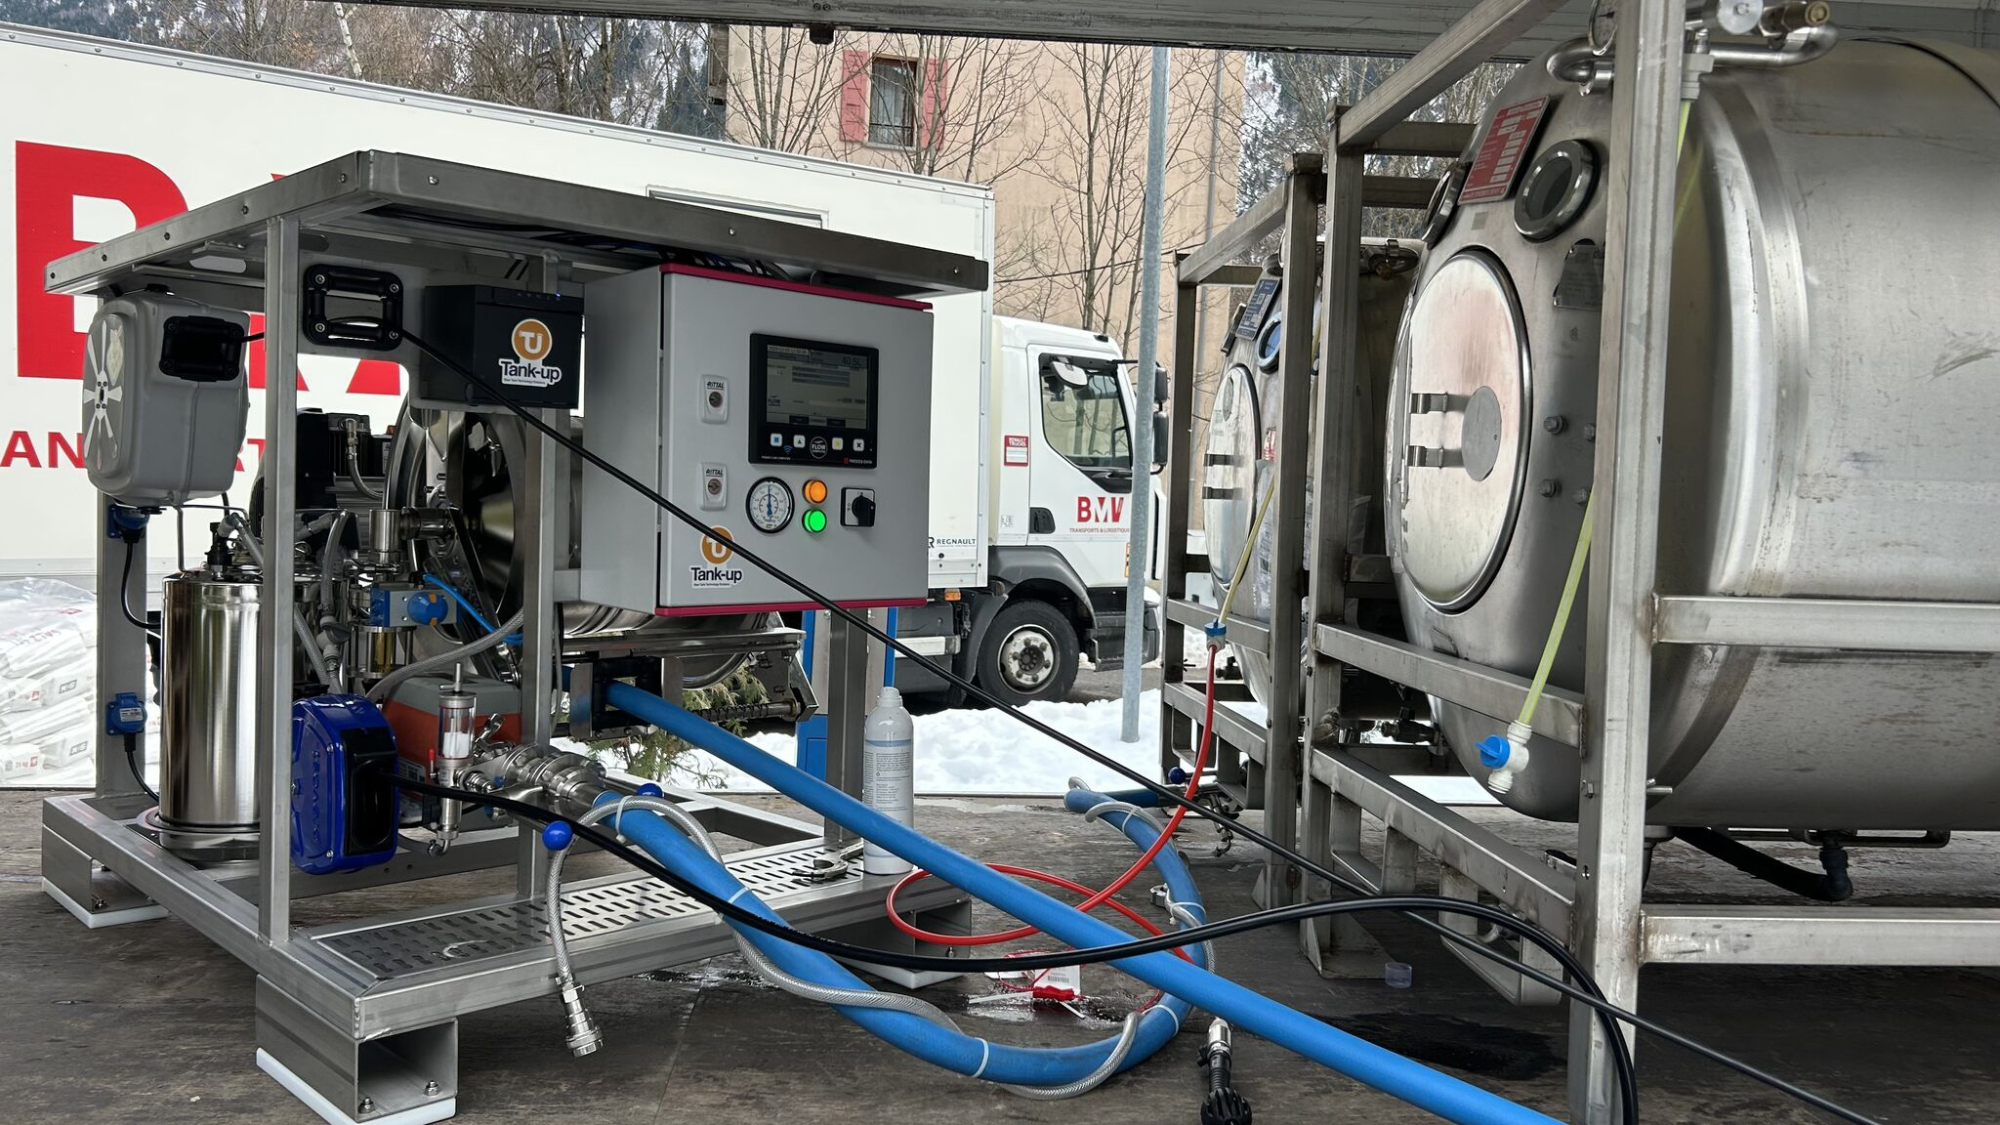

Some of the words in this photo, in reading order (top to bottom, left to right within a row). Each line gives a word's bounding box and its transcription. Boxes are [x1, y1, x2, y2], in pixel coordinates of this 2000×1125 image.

[500, 360, 561, 383] Tank-up
[706, 381, 725, 389] RITTAL
[705, 468, 724, 476] RITTAL
[1077, 496, 1124, 523] BMV
[690, 566, 743, 584] Tank-up
